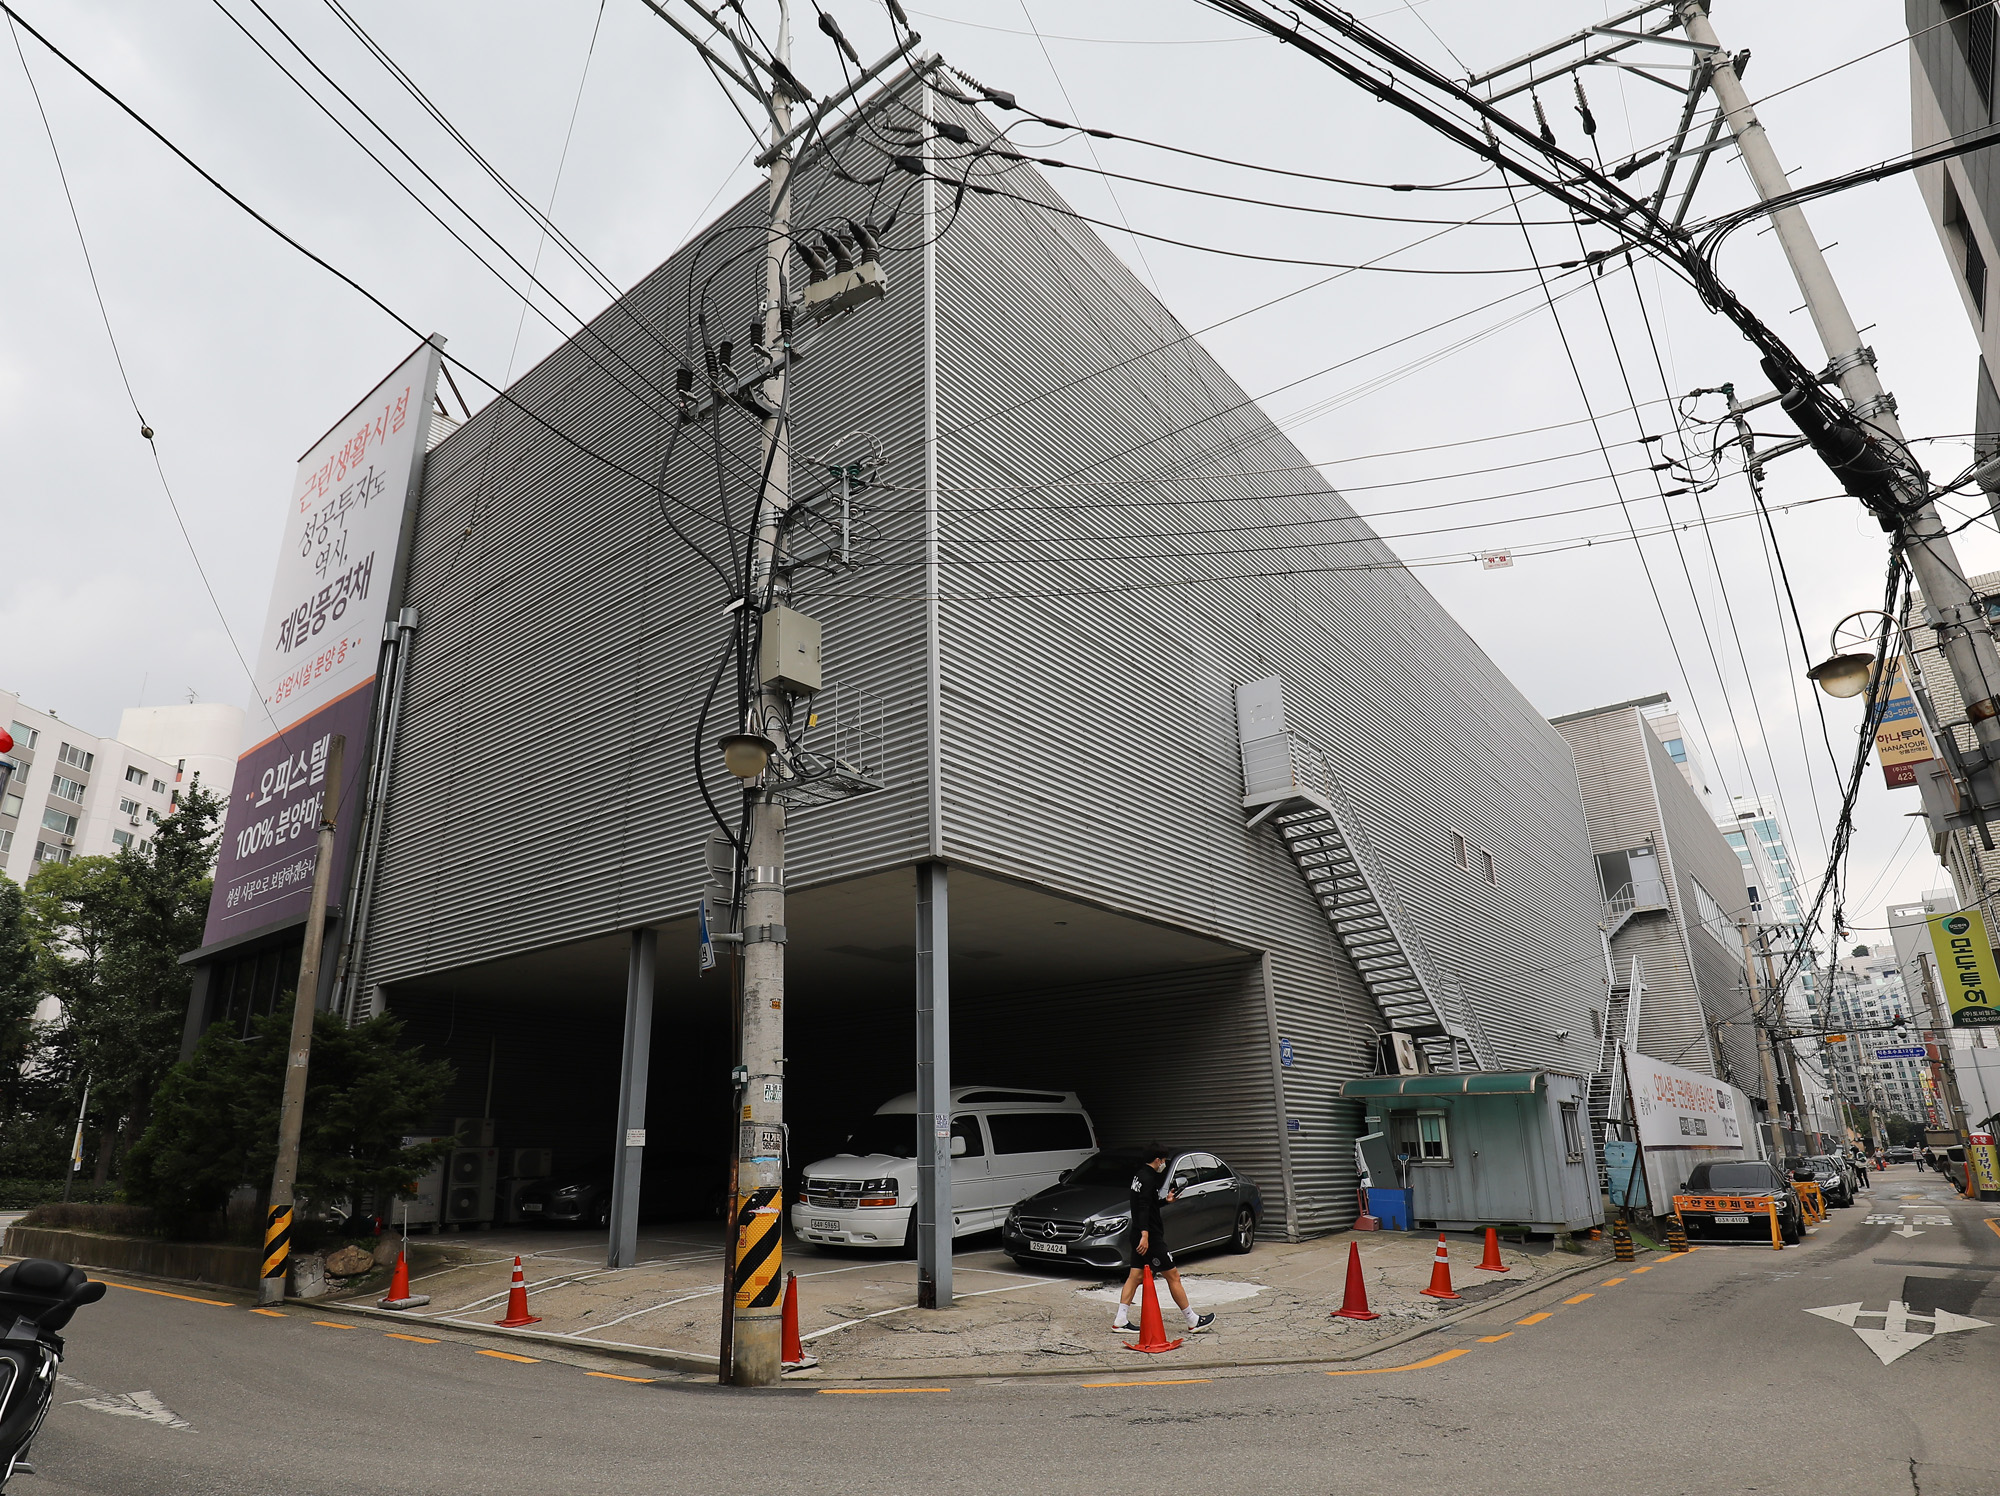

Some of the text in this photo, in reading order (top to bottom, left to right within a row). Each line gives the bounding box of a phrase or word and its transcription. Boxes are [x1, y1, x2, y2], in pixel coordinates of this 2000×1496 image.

[300, 386, 411, 514] 근린생활시설
[298, 465, 386, 557] 성공투자도
[315, 529, 348, 579] 역시,
[275, 551, 375, 653] 제일풍경채
[275, 638, 349, 704] 상업시설 분양 중
[1876, 728, 1925, 744] 하나투어
[1881, 740, 1926, 753] HANATOUR
[255, 733, 331, 808] 오피스텔
[1897, 772, 1915, 781] 423-
[236, 791, 326, 861] 100% 분양마
[226, 887, 241, 908] 성실
[269, 854, 317, 891] 보답하겠습니
[1950, 938, 1987, 1004] 모두투어
[1976, 1147, 1994, 1182] 삼겹살
[1690, 1199, 1755, 1208] 안전 제일
[1047, 1244, 1064, 1253] 2424
